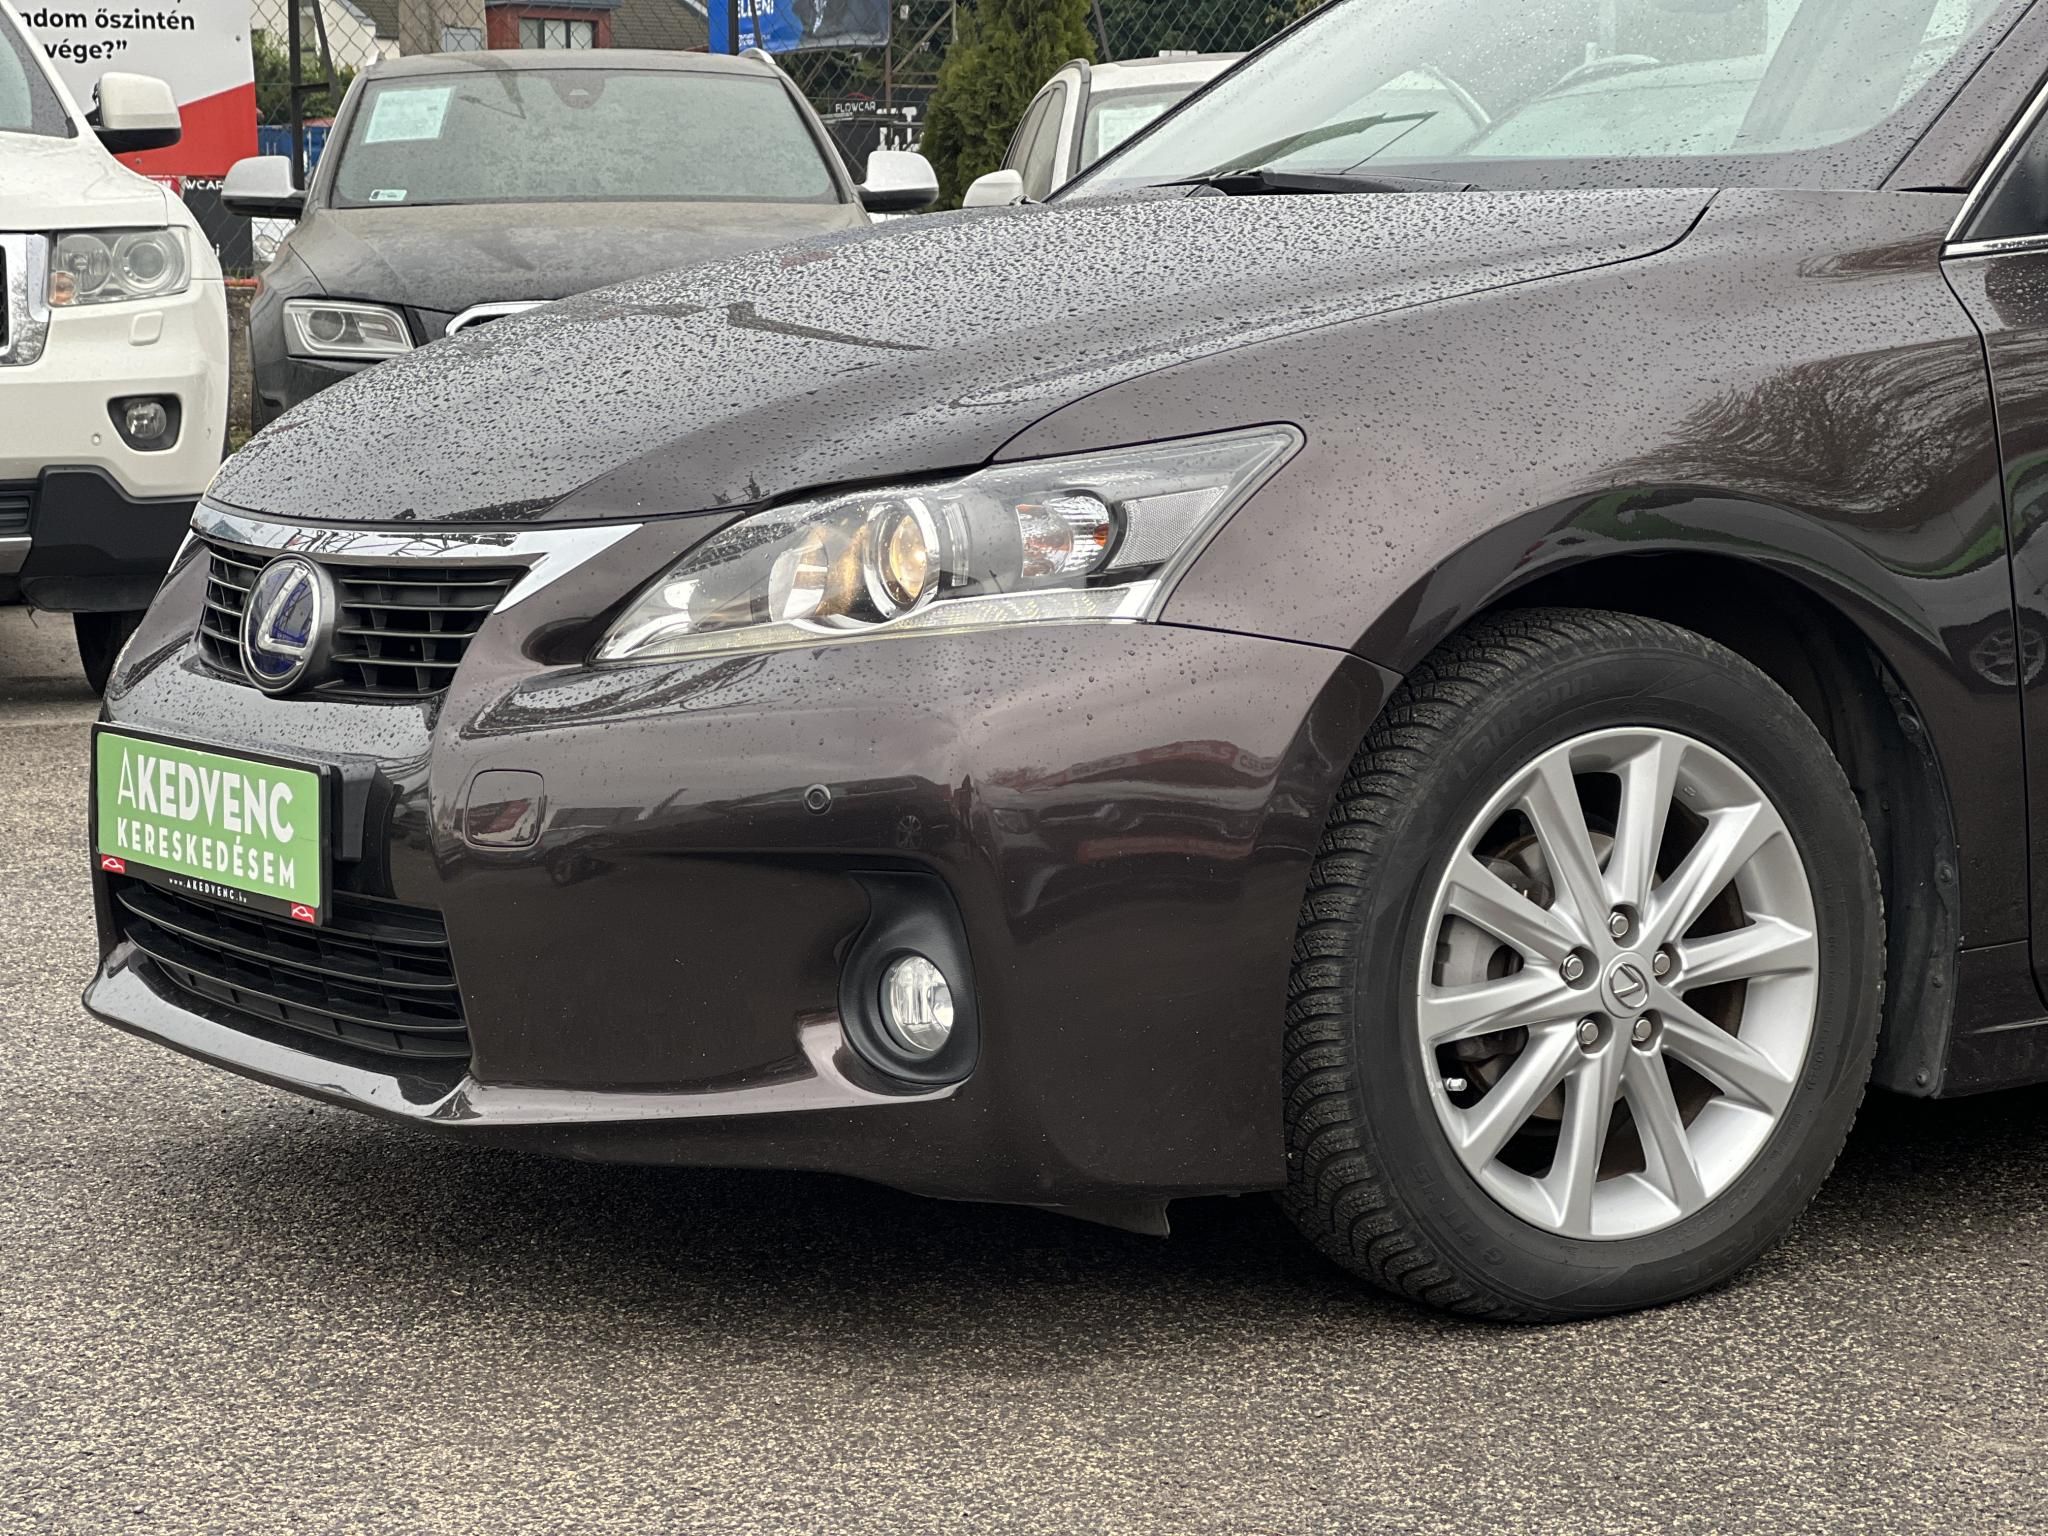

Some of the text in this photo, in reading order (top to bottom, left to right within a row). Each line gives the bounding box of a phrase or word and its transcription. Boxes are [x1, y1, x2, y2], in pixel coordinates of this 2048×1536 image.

[95, 8, 195, 30] őszintén
[835, 101, 876, 112] FLOWCAR
[117, 816, 295, 889] KERESKEDÉSEM
